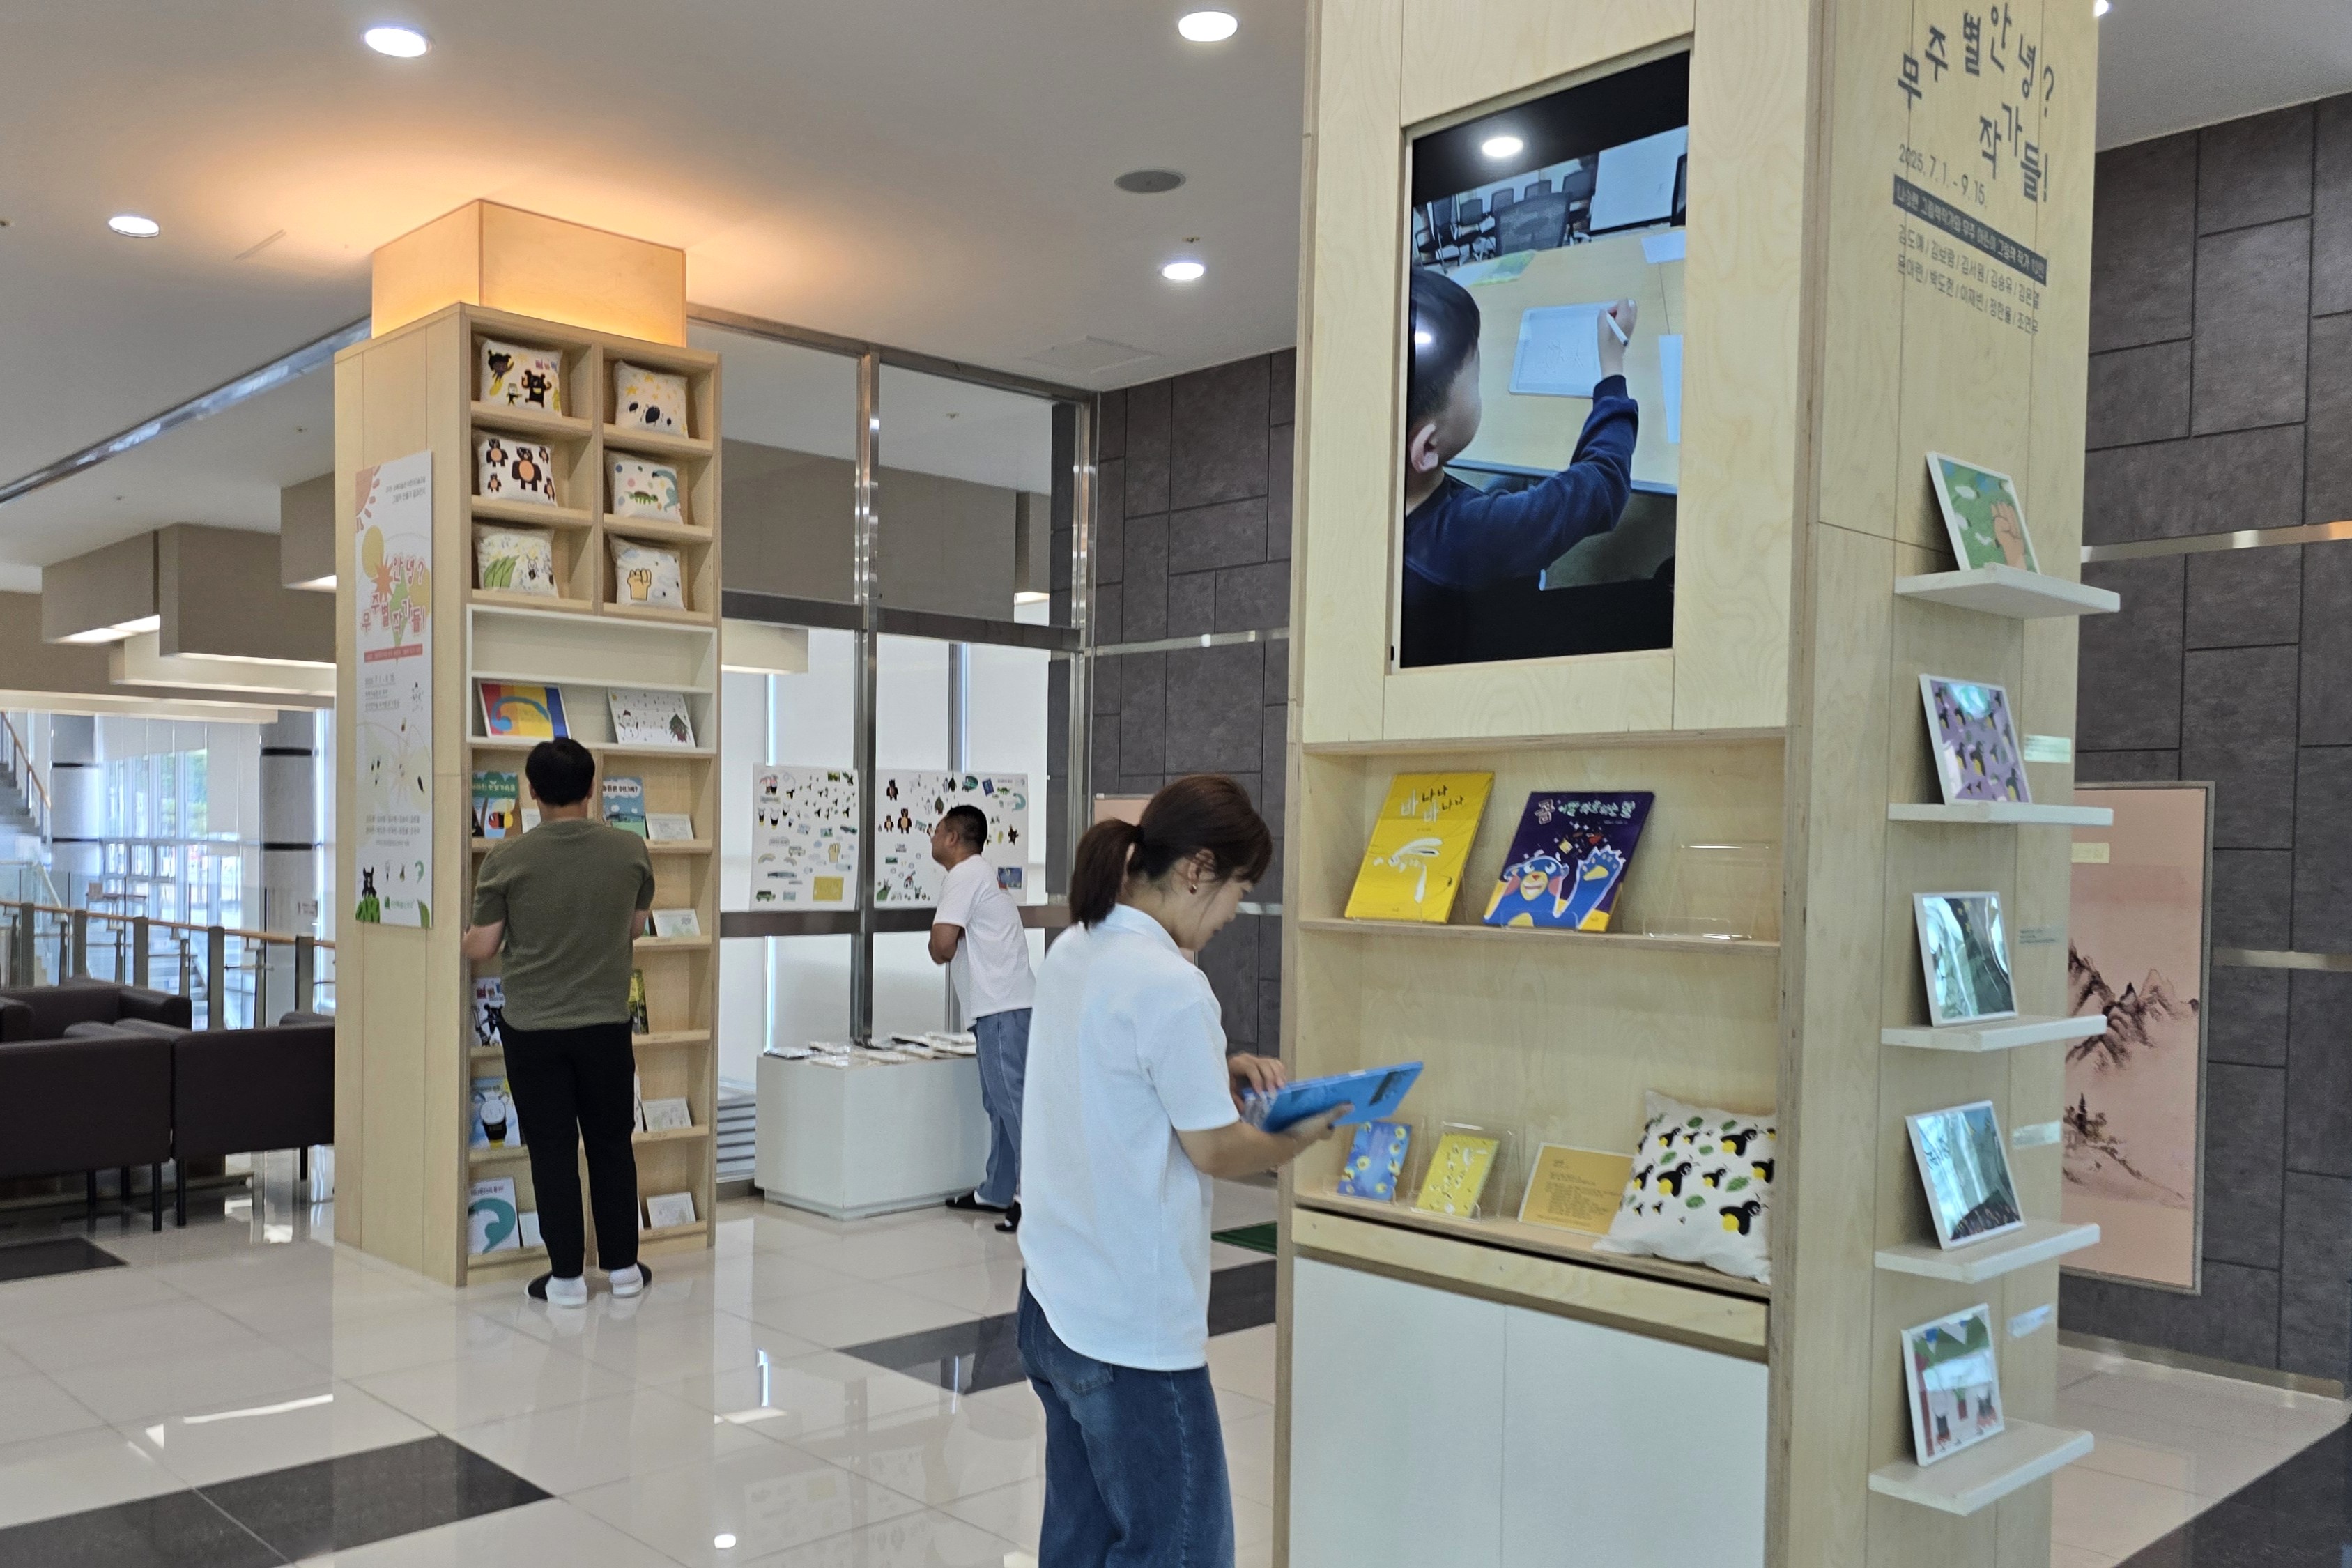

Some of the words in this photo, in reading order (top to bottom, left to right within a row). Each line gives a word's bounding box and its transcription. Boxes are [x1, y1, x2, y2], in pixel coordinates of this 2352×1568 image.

[1991, 2, 2054, 118] 안녕?
[1980, 102, 2047, 203] 작가들!
[393, 556, 424, 585] 안녕?
[393, 597, 425, 636] 작가들!
